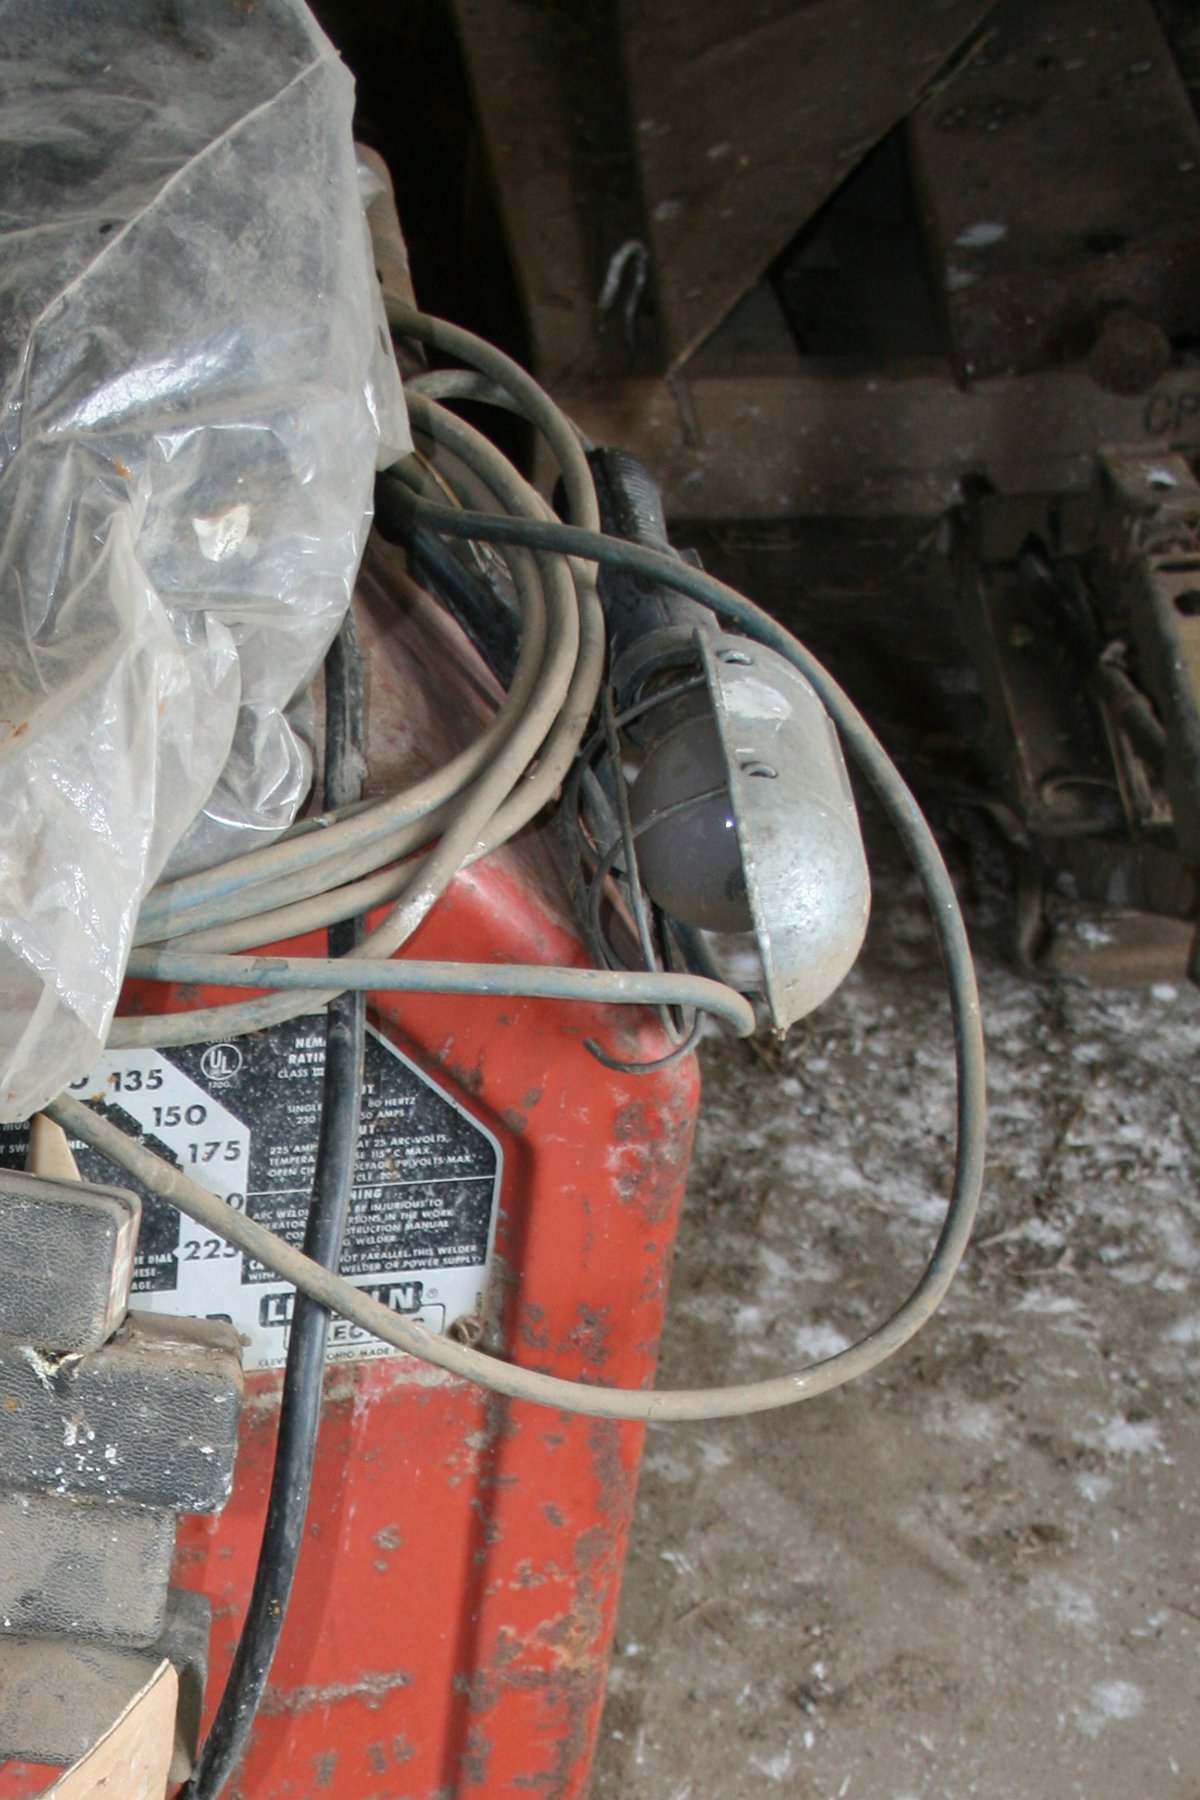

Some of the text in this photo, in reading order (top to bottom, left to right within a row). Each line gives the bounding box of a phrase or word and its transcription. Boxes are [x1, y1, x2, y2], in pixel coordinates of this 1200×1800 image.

[288, 1052, 326, 1065] RATIN
[277, 1068, 309, 1079] CLASS
[111, 1068, 164, 1093] 135
[384, 1097, 416, 1107] HERTZ
[152, 1103, 208, 1128] 150
[295, 1115, 316, 1125] 230
[376, 1109, 405, 1119] AMPS
[390, 1137, 411, 1146] ARC
[187, 1140, 241, 1164] 175
[269, 1155, 316, 1167] TEMPERA
[350, 1188, 382, 1200] NING
[276, 1208, 309, 1219] WELDI
[370, 1200, 425, 1212] INJURIOUS
[429, 1199, 444, 1208] TO
[401, 1211, 418, 1220] THE
[422, 1209, 454, 1219] WORK
[346, 1221, 450, 1235] STRUCTION MANUAL
[413, 1248, 434, 1257] THIS
[438, 1244, 477, 1255] WELDER
[148, 1252, 173, 1265] DIAL
[341, 1261, 382, 1274] WELDER
[385, 1260, 400, 1270] OR
[402, 1258, 439, 1269] POWER
[359, 1347, 389, 1357] MADE
